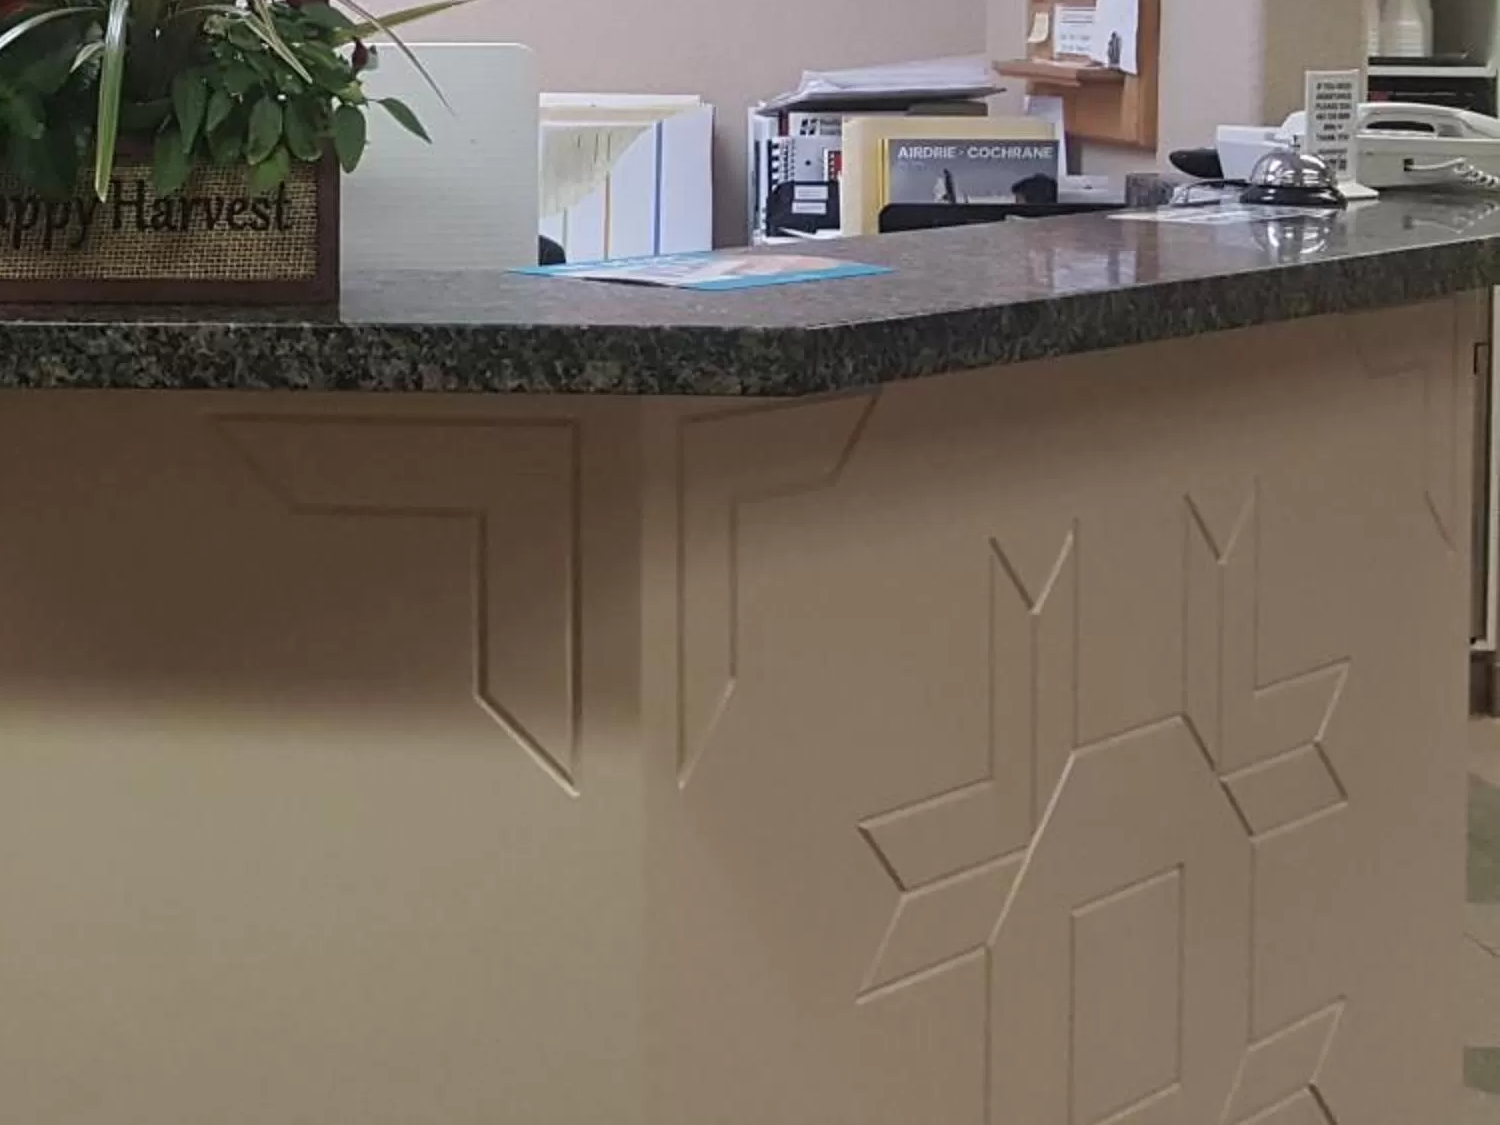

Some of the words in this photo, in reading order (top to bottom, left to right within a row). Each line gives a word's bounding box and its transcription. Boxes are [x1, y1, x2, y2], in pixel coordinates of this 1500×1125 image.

[897, 145, 957, 160] AIRDRIE
[966, 145, 1054, 160] COCHRANE
[111, 178, 294, 233] Harvest
